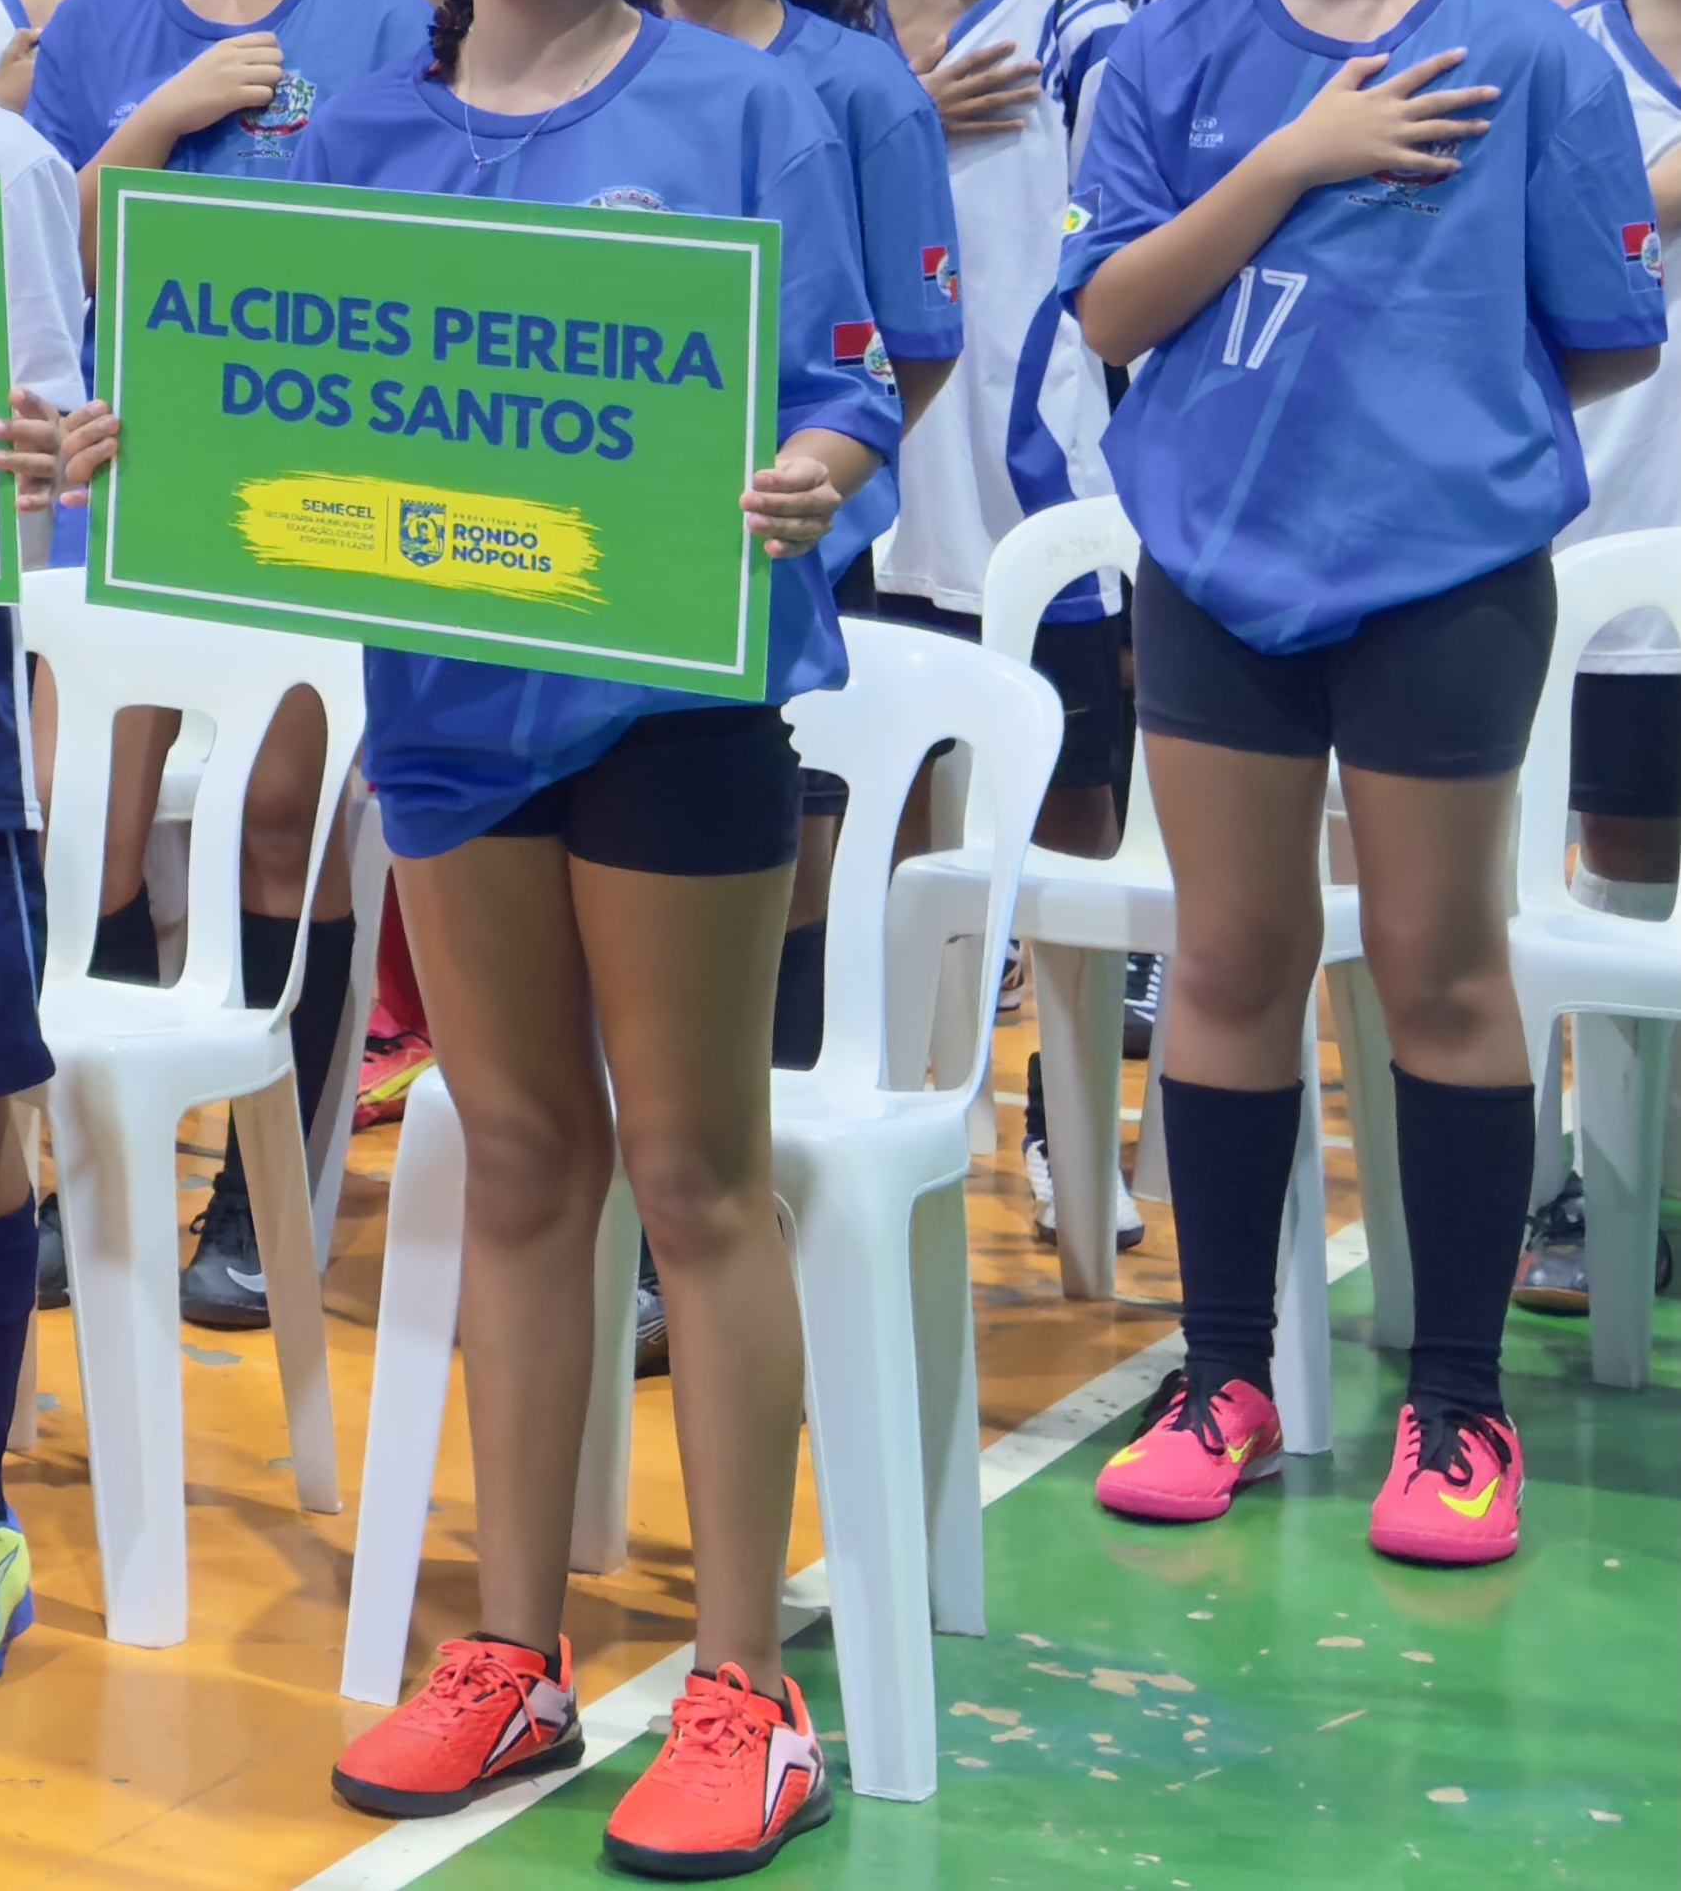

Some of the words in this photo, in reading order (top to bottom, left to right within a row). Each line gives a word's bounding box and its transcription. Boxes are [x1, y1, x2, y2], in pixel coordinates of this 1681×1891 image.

[146, 278, 410, 358] ALCIDES
[431, 305, 724, 390] PEREIRA
[1222, 265, 1308, 369] 17
[221, 361, 352, 429] DOS
[369, 383, 634, 461] SANTOS
[302, 499, 375, 519] SEMECEL
[453, 523, 539, 550] RONDO
[452, 545, 551, 573] NÓPOLIS
